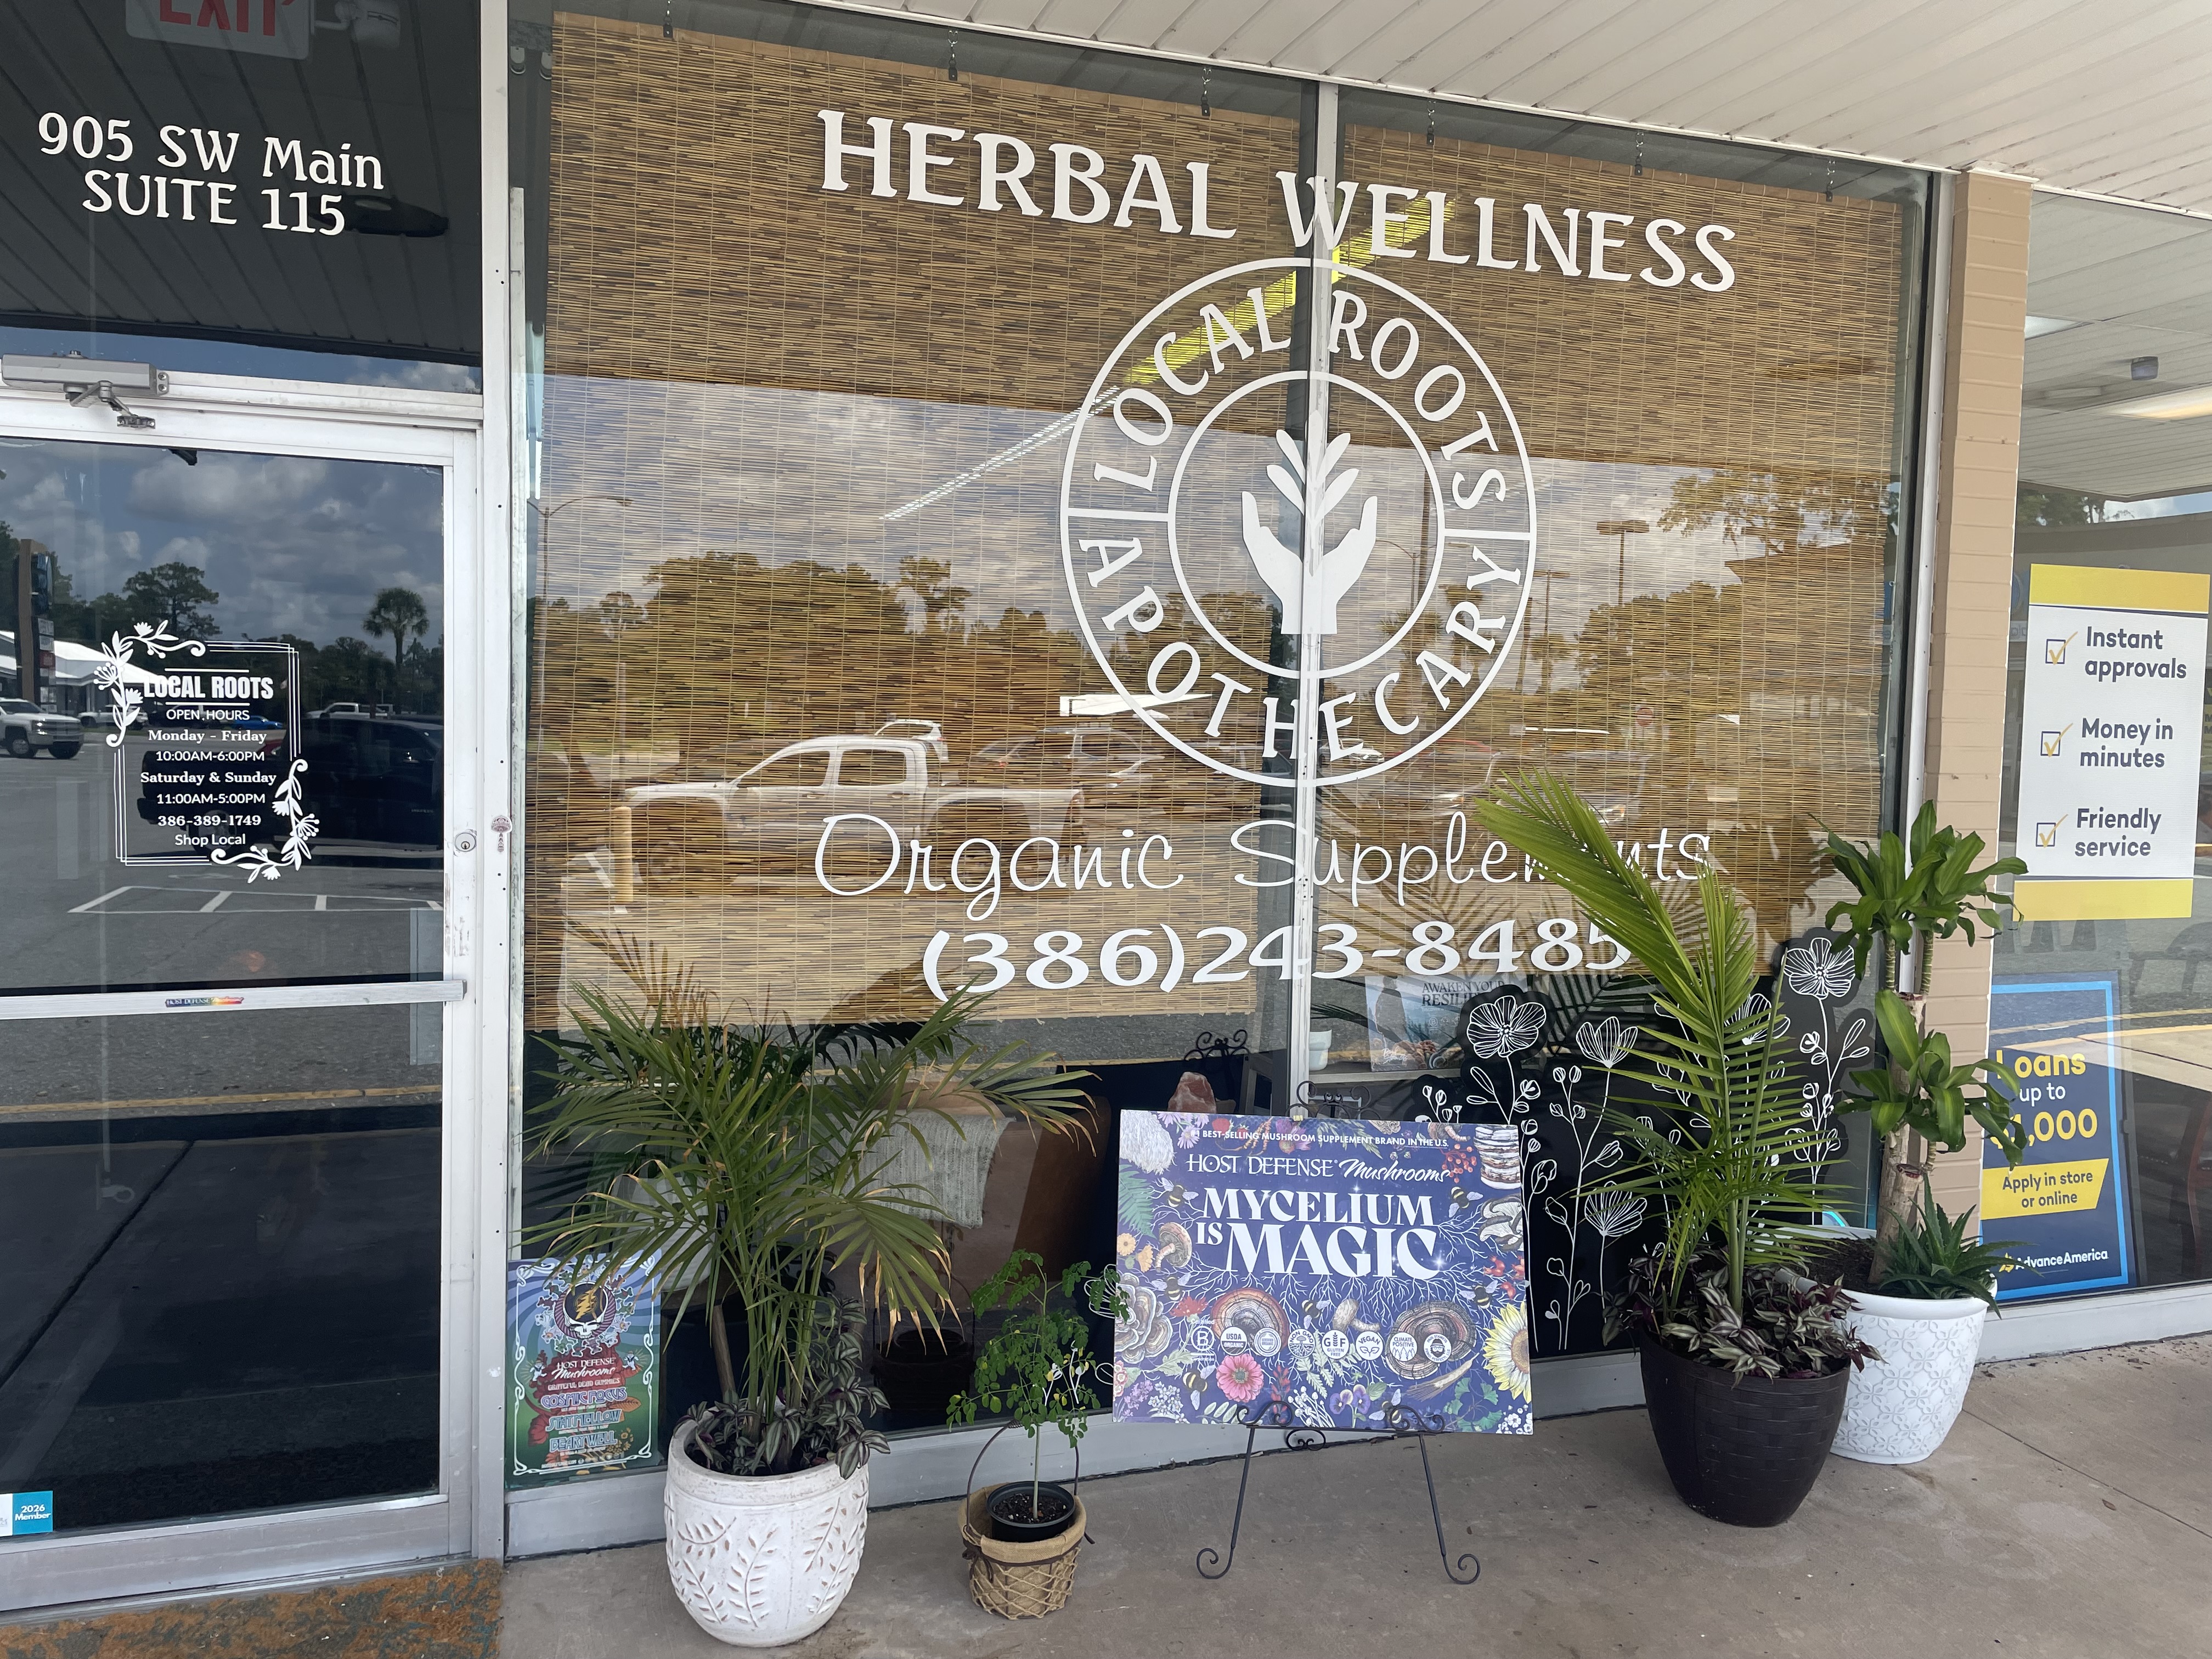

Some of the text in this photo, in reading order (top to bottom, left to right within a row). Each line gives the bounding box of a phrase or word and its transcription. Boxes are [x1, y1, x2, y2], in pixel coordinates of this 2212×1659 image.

[38, 112, 385, 190] 905 SW Main
[83, 170, 345, 235] SUITE 115
[817, 109, 1735, 292] HERBAL WELLNESS
[1094, 287, 1506, 510] LOCAL ROOTS
[1079, 538, 1521, 761] APOTHECARY
[2086, 627, 2163, 650] Instant
[2085, 658, 2187, 682] approvals
[144, 675, 274, 699] LOCAL ROOTS
[166, 710, 250, 720] OPEN HOURS
[149, 730, 205, 744] Monday
[222, 730, 267, 745] Friday
[2081, 718, 2173, 744] Money in
[156, 751, 264, 761] 10:00AM-6:00PM
[2080, 745, 2165, 768] minutes
[140, 772, 276, 786] Saturday & Sunday
[157, 794, 266, 804] 11:00AM-5:00PM
[158, 815, 261, 826] 386-389-1749
[2076, 808, 2162, 834] Friendly
[175, 834, 246, 847] Shop Local
[2075, 836, 2151, 857] service
[815, 814, 1183, 921] Organic
[923, 918, 1632, 1002] (386)243-8485
[1422, 982, 1471, 993] AWAKEN
[2019, 1082, 2066, 1107] up to
[1203, 1131, 1259, 1139] BEST-SELLING
[1262, 1133, 1315, 1142] MUSHROOM
[1318, 1135, 1375, 1144] SUPPLEMENT
[1375, 1137, 1405, 1146] BRAND
[1185, 1154, 1451, 1182] HOST DEFENSE Mushrooms
[2002, 1171, 2093, 1193] Apply in store
[1203, 1187, 1436, 1227] MYCELIUM
[2022, 1191, 2078, 1208] or online
[1195, 1223, 1440, 1277] IS MAGIC
[1290, 1331, 1300, 1344] NON
[1303, 1330, 1313, 1344] GMO
[552, 1367, 616, 1379] Mushrooms
[557, 1358, 615, 1370] HOST DEFENSE
[548, 1382, 577, 1391] GRATEFUL
[595, 1378, 620, 1386] GUMMIES
[541, 1391, 587, 1409] COSMIC
[588, 1387, 628, 1404] FOCUS
[545, 1415, 575, 1431] STAY
[575, 1409, 622, 1428] MELLOW
[585, 1431, 618, 1448] WELL
[15, 1512, 51, 1521] Member
[21, 1504, 45, 1513] 2026
